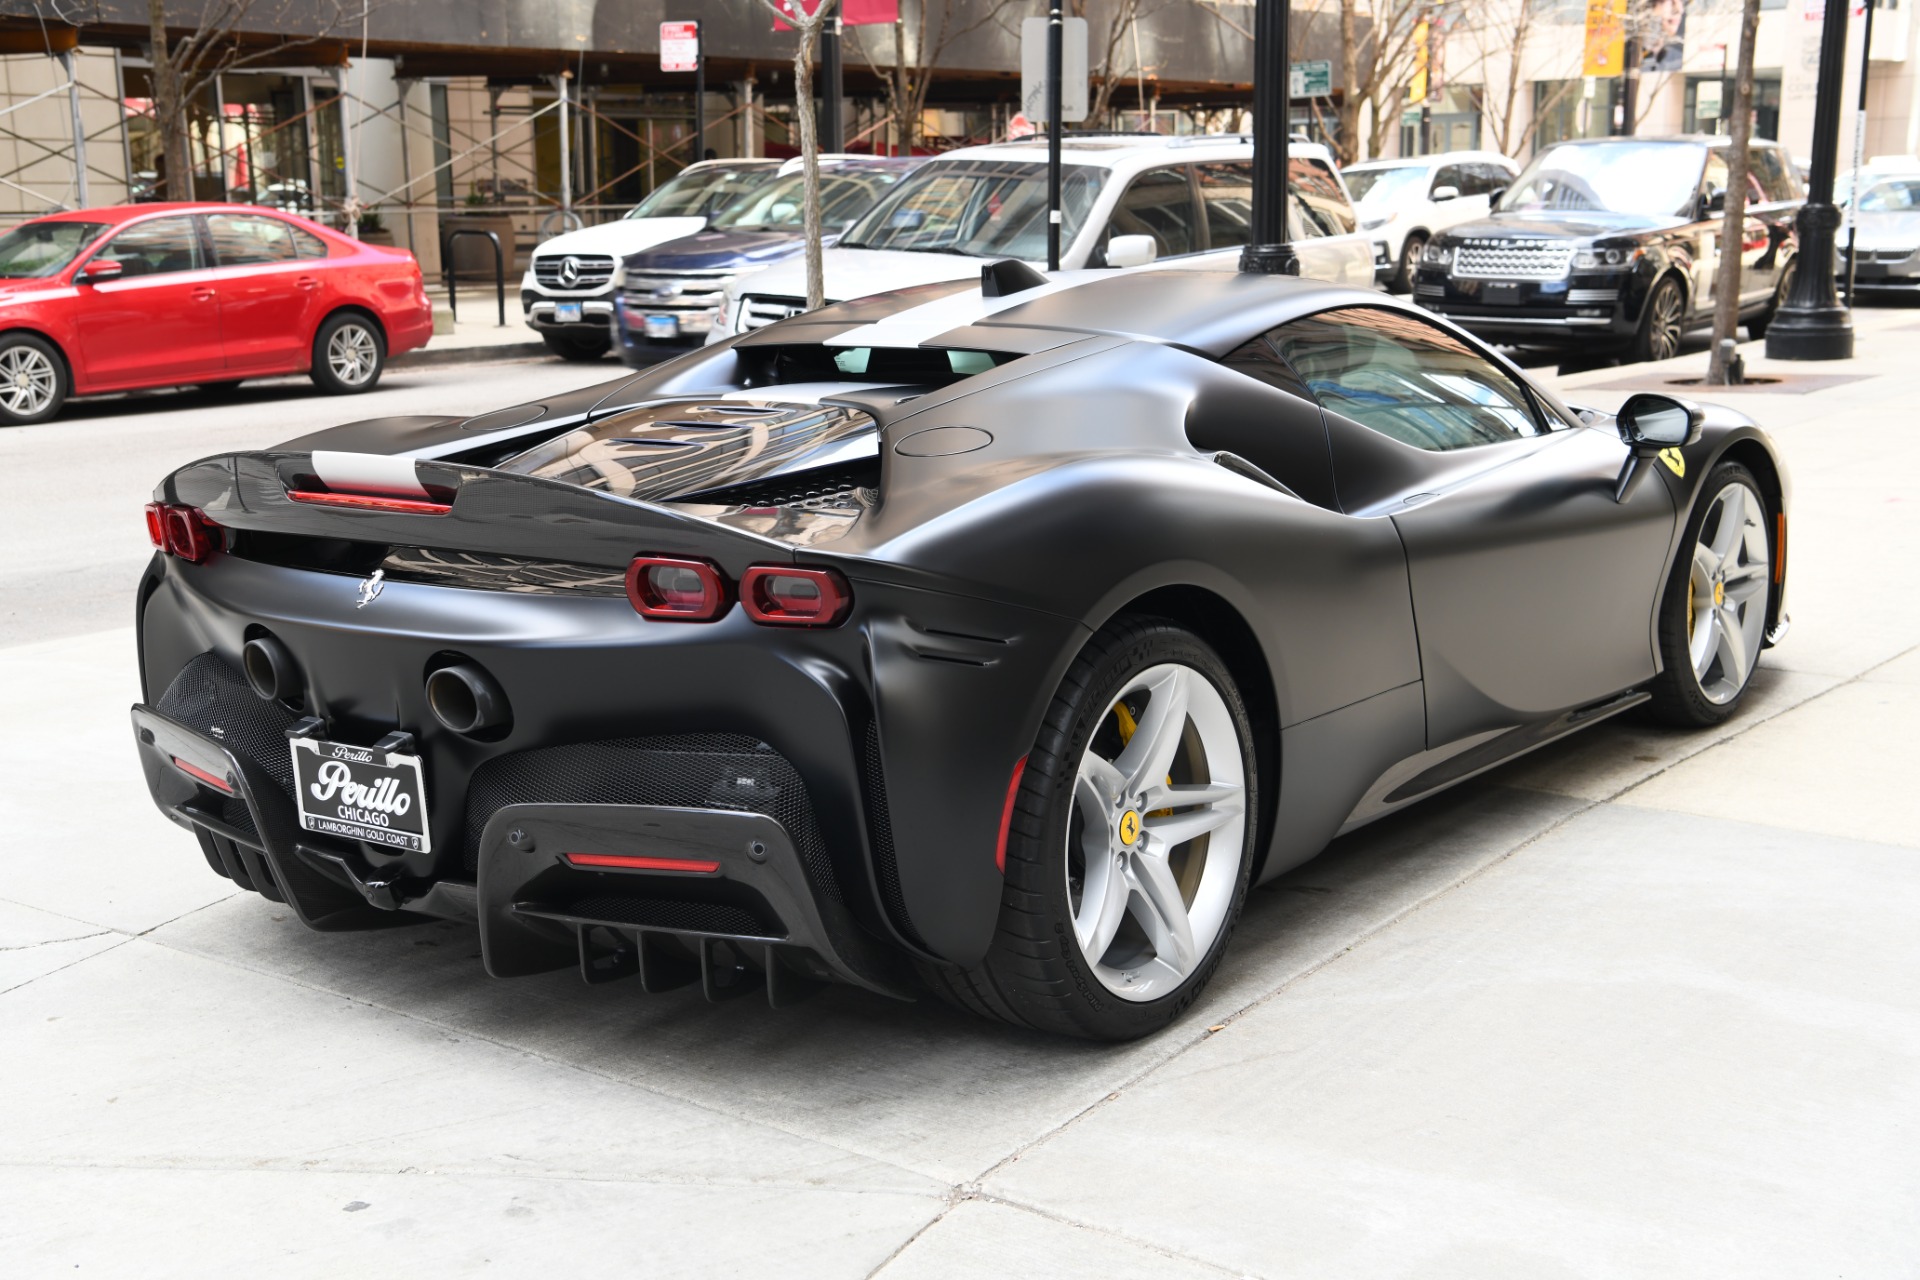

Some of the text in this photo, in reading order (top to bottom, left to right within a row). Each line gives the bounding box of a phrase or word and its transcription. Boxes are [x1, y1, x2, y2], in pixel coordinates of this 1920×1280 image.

[1463, 238, 1509, 247] RANGE
[332, 746, 373, 762] Perillo
[310, 761, 411, 816] Perillo
[337, 805, 389, 827] CHICAGO
[318, 820, 408, 846] LAMBORGHINI GOLD COAST
[1065, 959, 1088, 991] Sport
[1083, 989, 1105, 1012] Pilot
